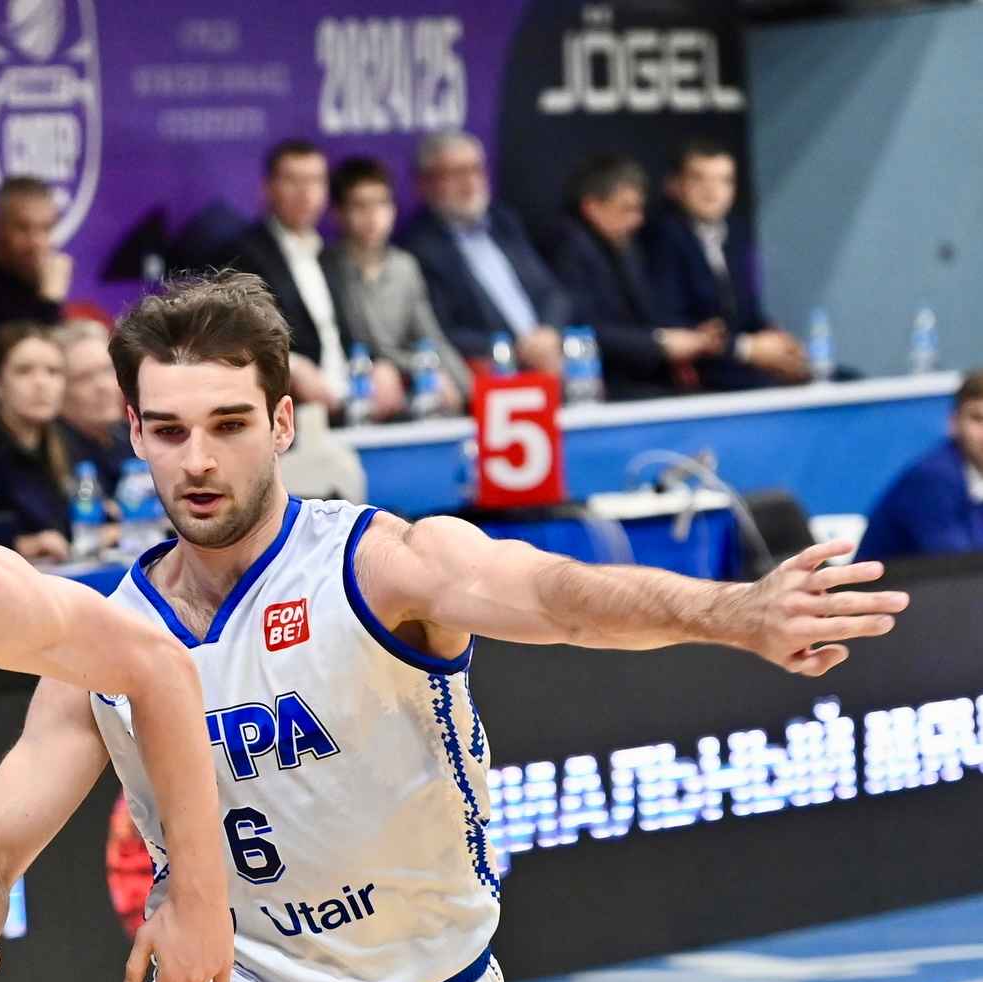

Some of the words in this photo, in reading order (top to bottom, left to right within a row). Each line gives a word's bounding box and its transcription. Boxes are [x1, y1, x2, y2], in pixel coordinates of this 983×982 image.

[483, 386, 552, 491] 5
[266, 605, 307, 628] FON
[269, 621, 307, 645] BET
[205, 690, 341, 782] РА
[221, 806, 287, 885] 6
[261, 882, 376, 937] Utair
